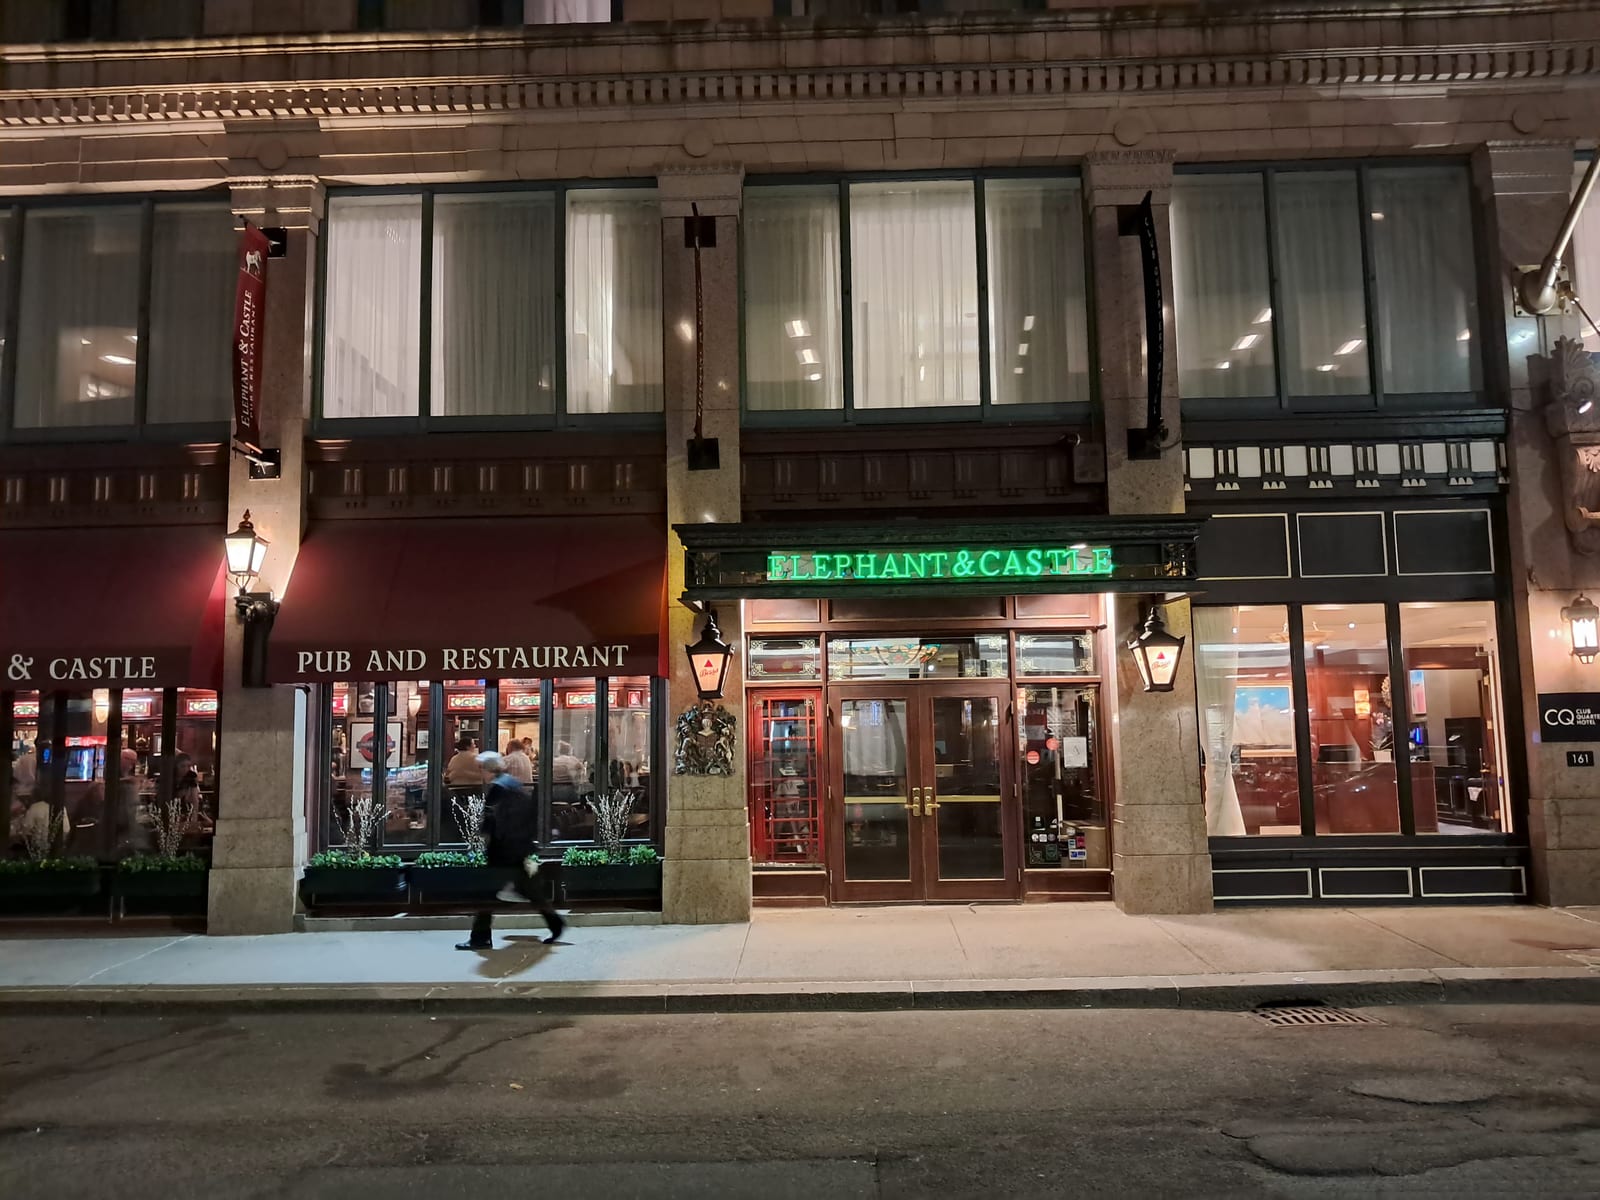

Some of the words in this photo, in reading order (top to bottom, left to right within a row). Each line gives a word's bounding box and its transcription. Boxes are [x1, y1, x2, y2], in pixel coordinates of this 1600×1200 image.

[238, 338, 249, 355] &
[7, 653, 34, 681] &
[49, 656, 156, 680] CASTLE
[297, 650, 351, 674] PUB
[366, 648, 427, 672] AND
[442, 645, 629, 670] RESTAURANT
[1544, 708, 1575, 726] CQ
[1572, 753, 1589, 764] 161
